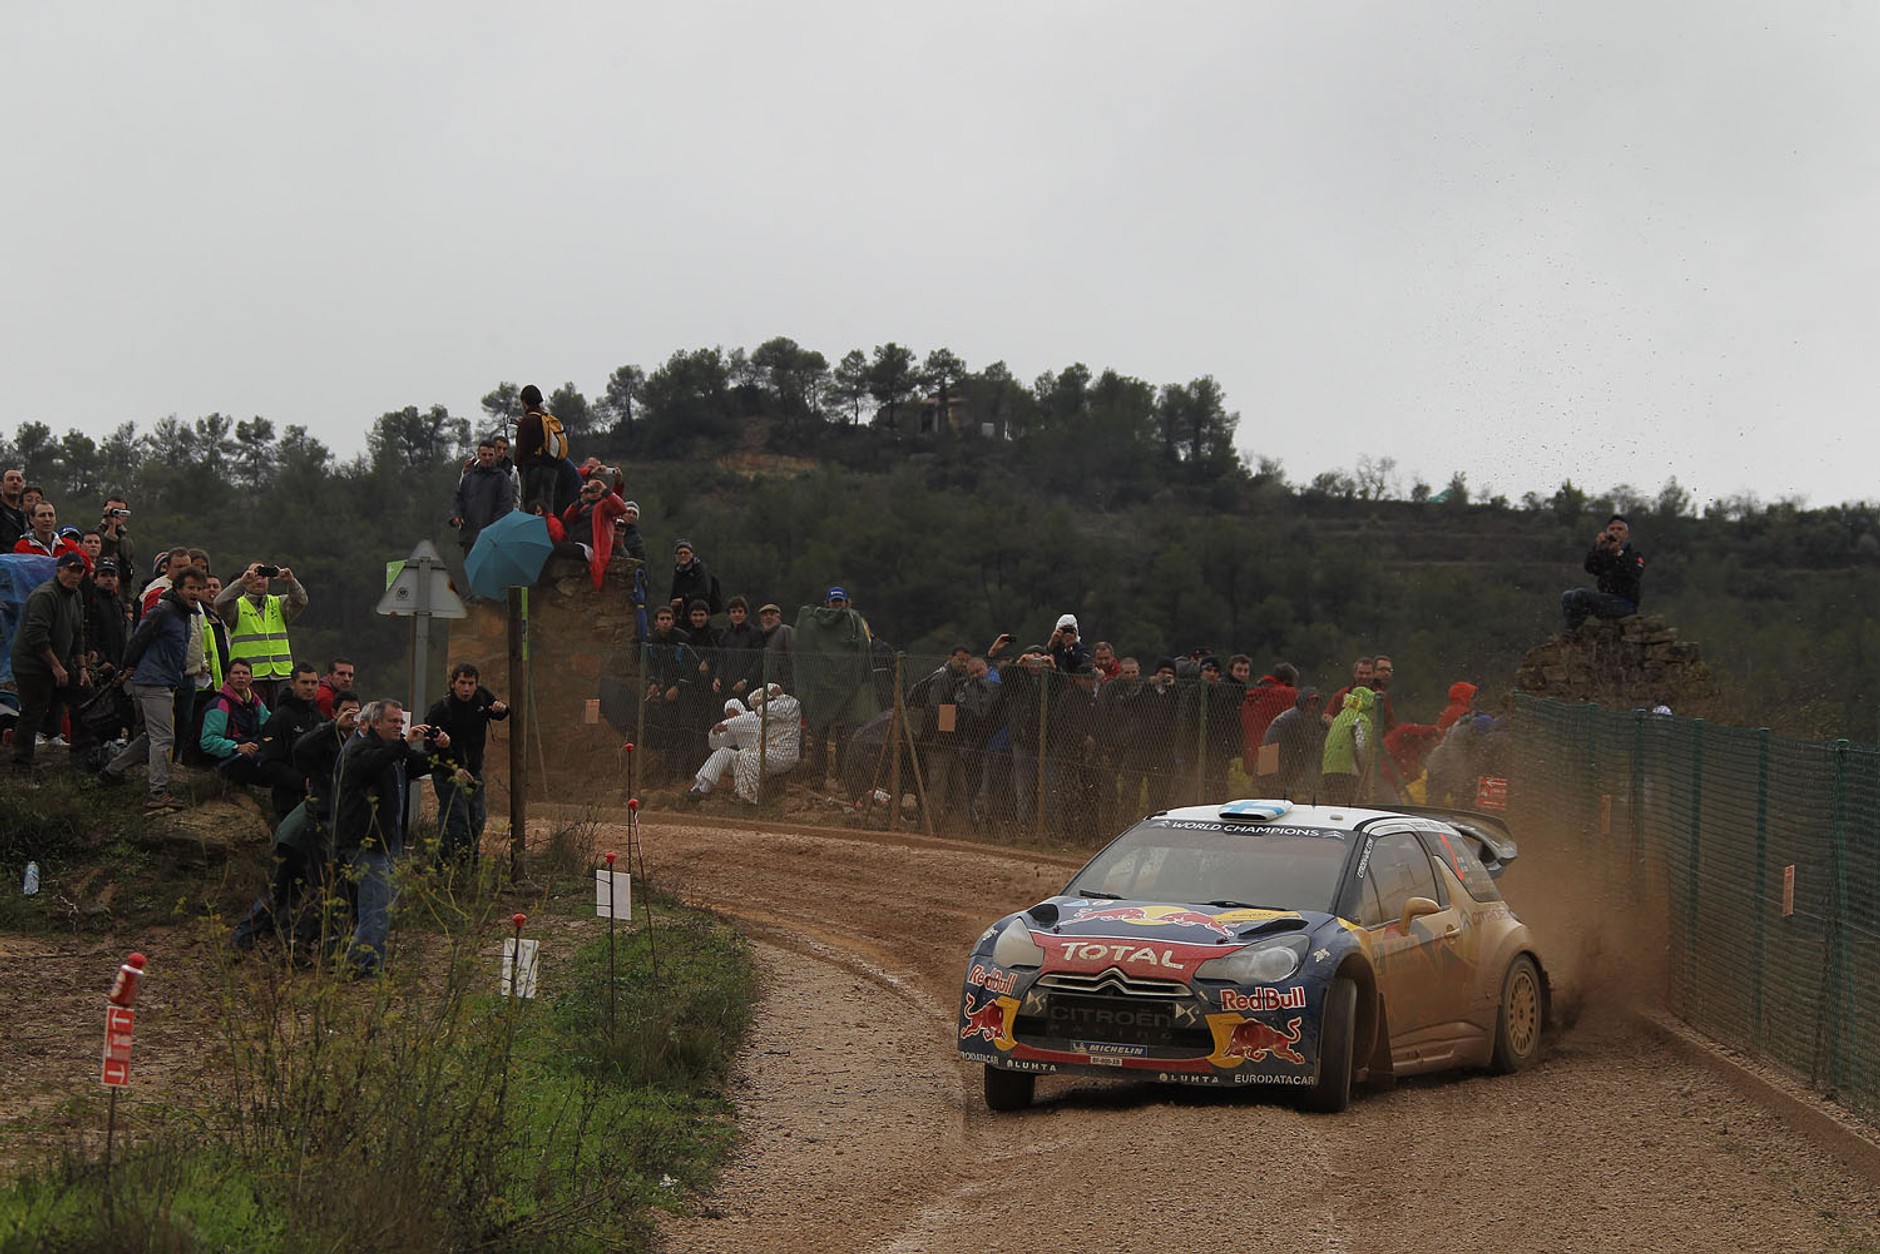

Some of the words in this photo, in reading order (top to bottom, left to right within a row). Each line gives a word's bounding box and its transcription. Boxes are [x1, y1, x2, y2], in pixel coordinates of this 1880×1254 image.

[1172, 821, 1222, 832] WORLD
[1223, 824, 1320, 837] CHAMPIONS
[1060, 941, 1185, 970] TOTAL
[1089, 1043, 1144, 1055] MICHELIN
[1014, 1061, 1057, 1072] LUHTA
[1170, 1073, 1220, 1084] LUHTA
[1234, 1073, 1315, 1086] EURODATACAR
